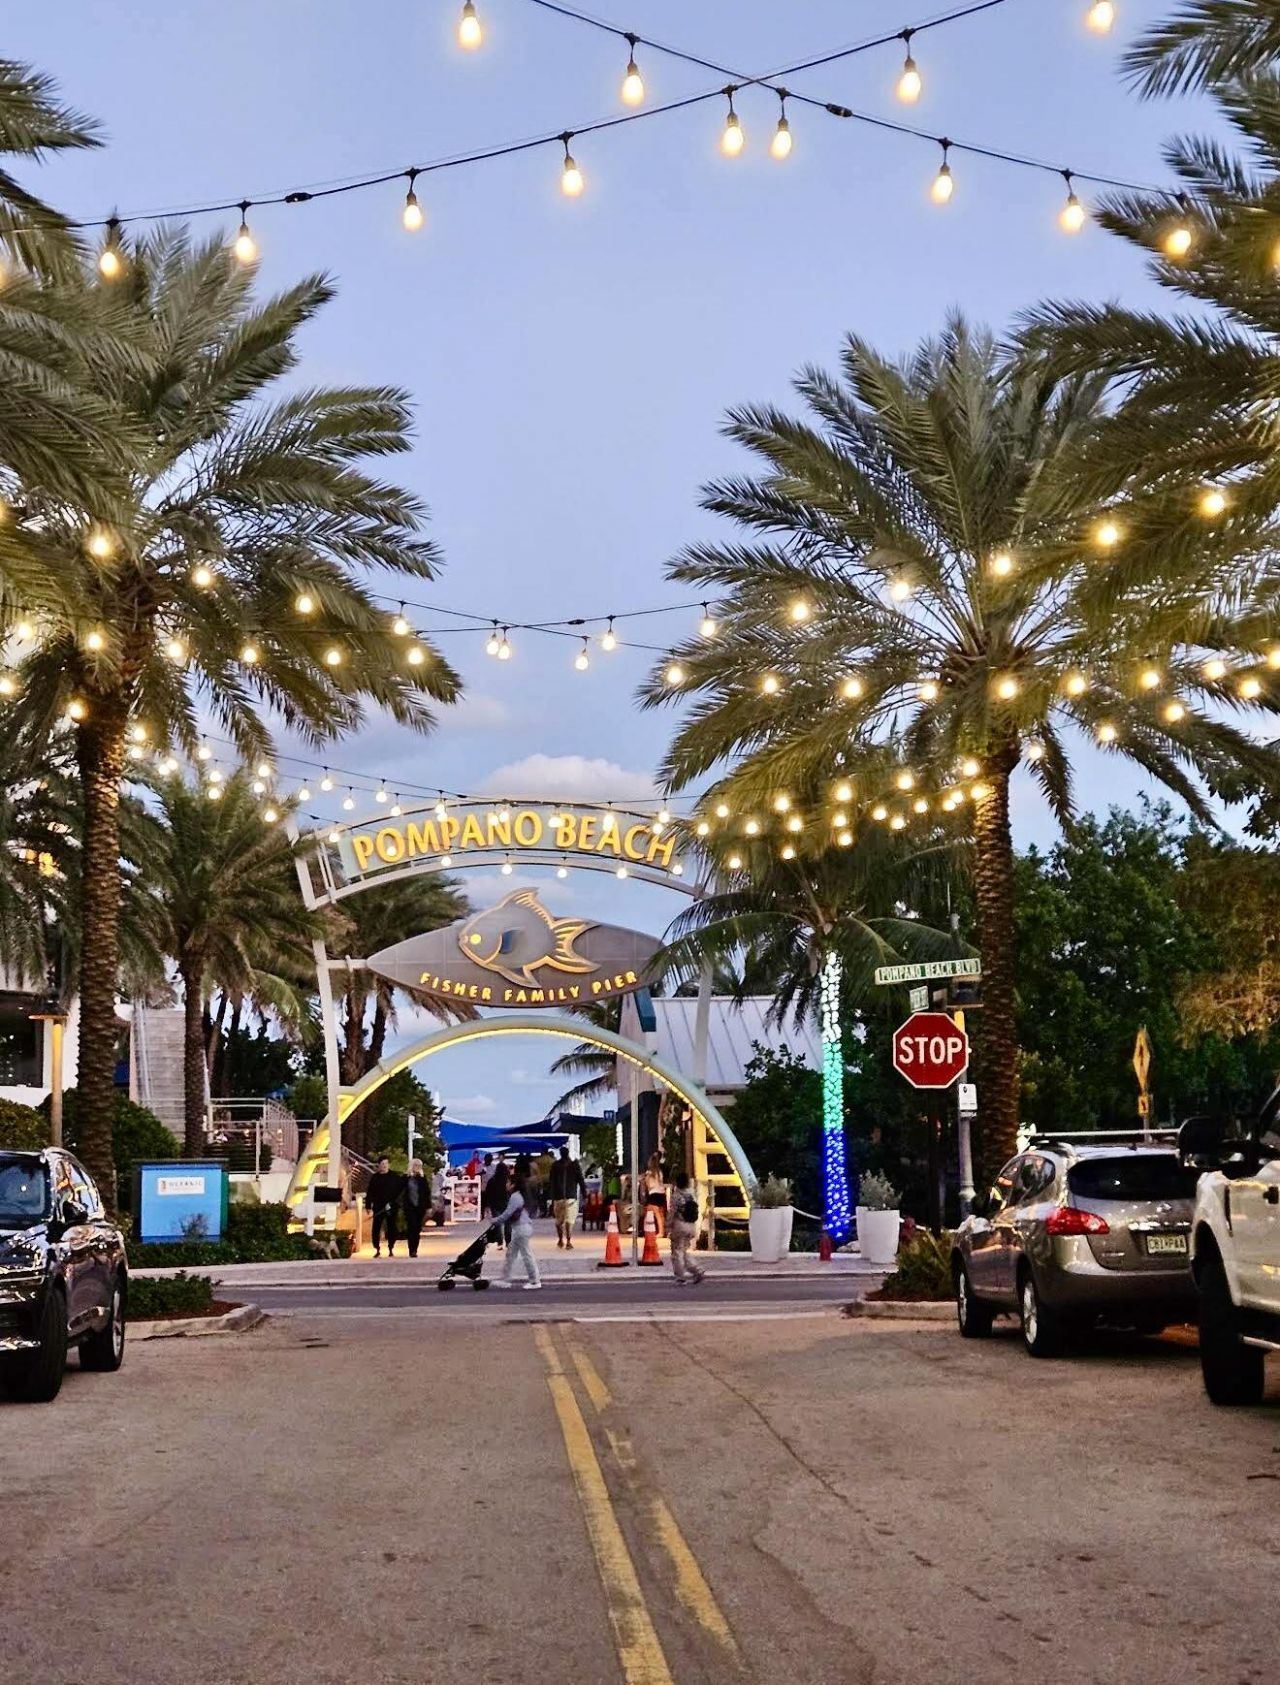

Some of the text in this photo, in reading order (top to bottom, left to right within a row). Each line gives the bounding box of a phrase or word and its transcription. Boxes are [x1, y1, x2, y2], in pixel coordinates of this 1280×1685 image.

[352, 811, 677, 870] POMPANO BEACH
[881, 960, 977, 981] POMPANO BEACH BLVD
[420, 970, 638, 1002] FISHER FAMILY PIER
[899, 1036, 963, 1064] STOP
